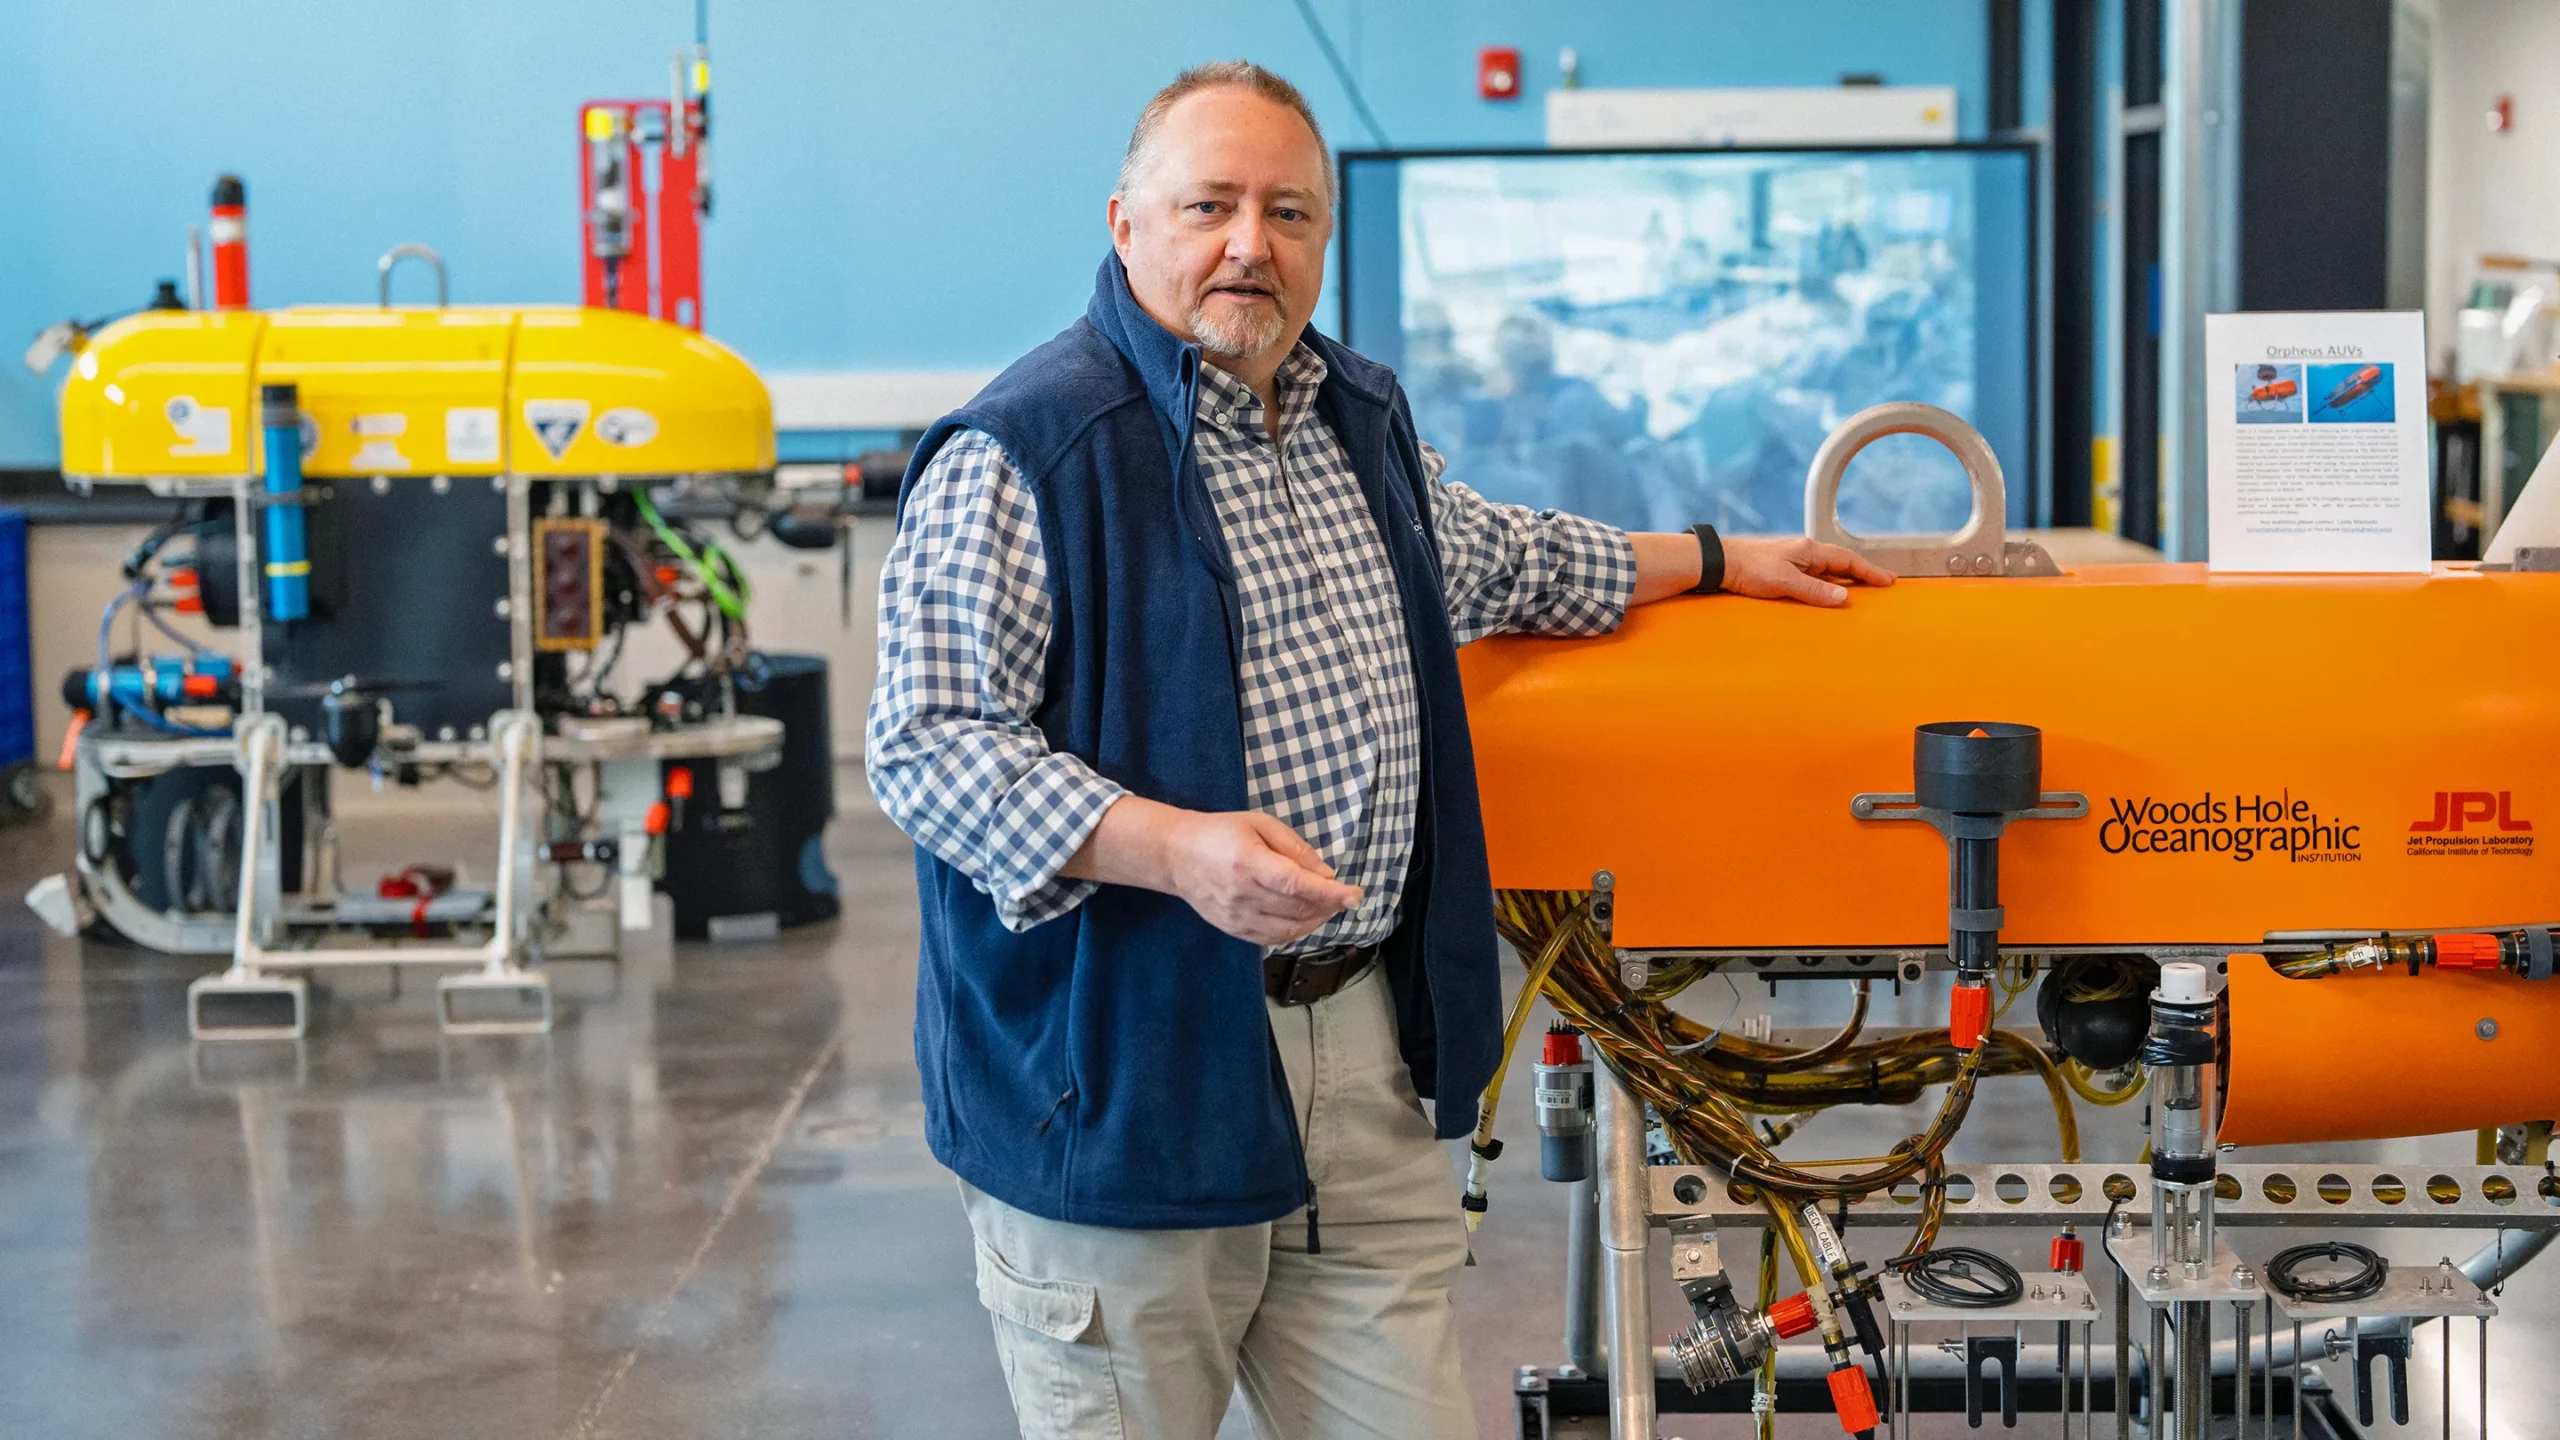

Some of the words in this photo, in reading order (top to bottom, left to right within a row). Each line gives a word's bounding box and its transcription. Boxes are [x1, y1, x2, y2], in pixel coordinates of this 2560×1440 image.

[2266, 345, 2323, 358] Orpheus
[2327, 345, 2363, 357] AUVs
[2109, 792, 2228, 826] Woods
[2235, 787, 2310, 823] Hole
[2409, 791, 2533, 832] JPL
[2099, 814, 2361, 863] Oceanographic
[2407, 836, 2423, 845] Jet
[2425, 836, 2480, 847] Propulsion
[2482, 836, 2534, 846] Laboratory
[2298, 853, 2361, 863] INSTITUTION
[2406, 847, 2446, 856] California
[2447, 847, 2479, 856] Institute
[2481, 847, 2489, 856] of
[2490, 847, 2534, 857] Technology
[1805, 1206, 1823, 1231] DECK
[1818, 1231, 1837, 1257] CABLE
